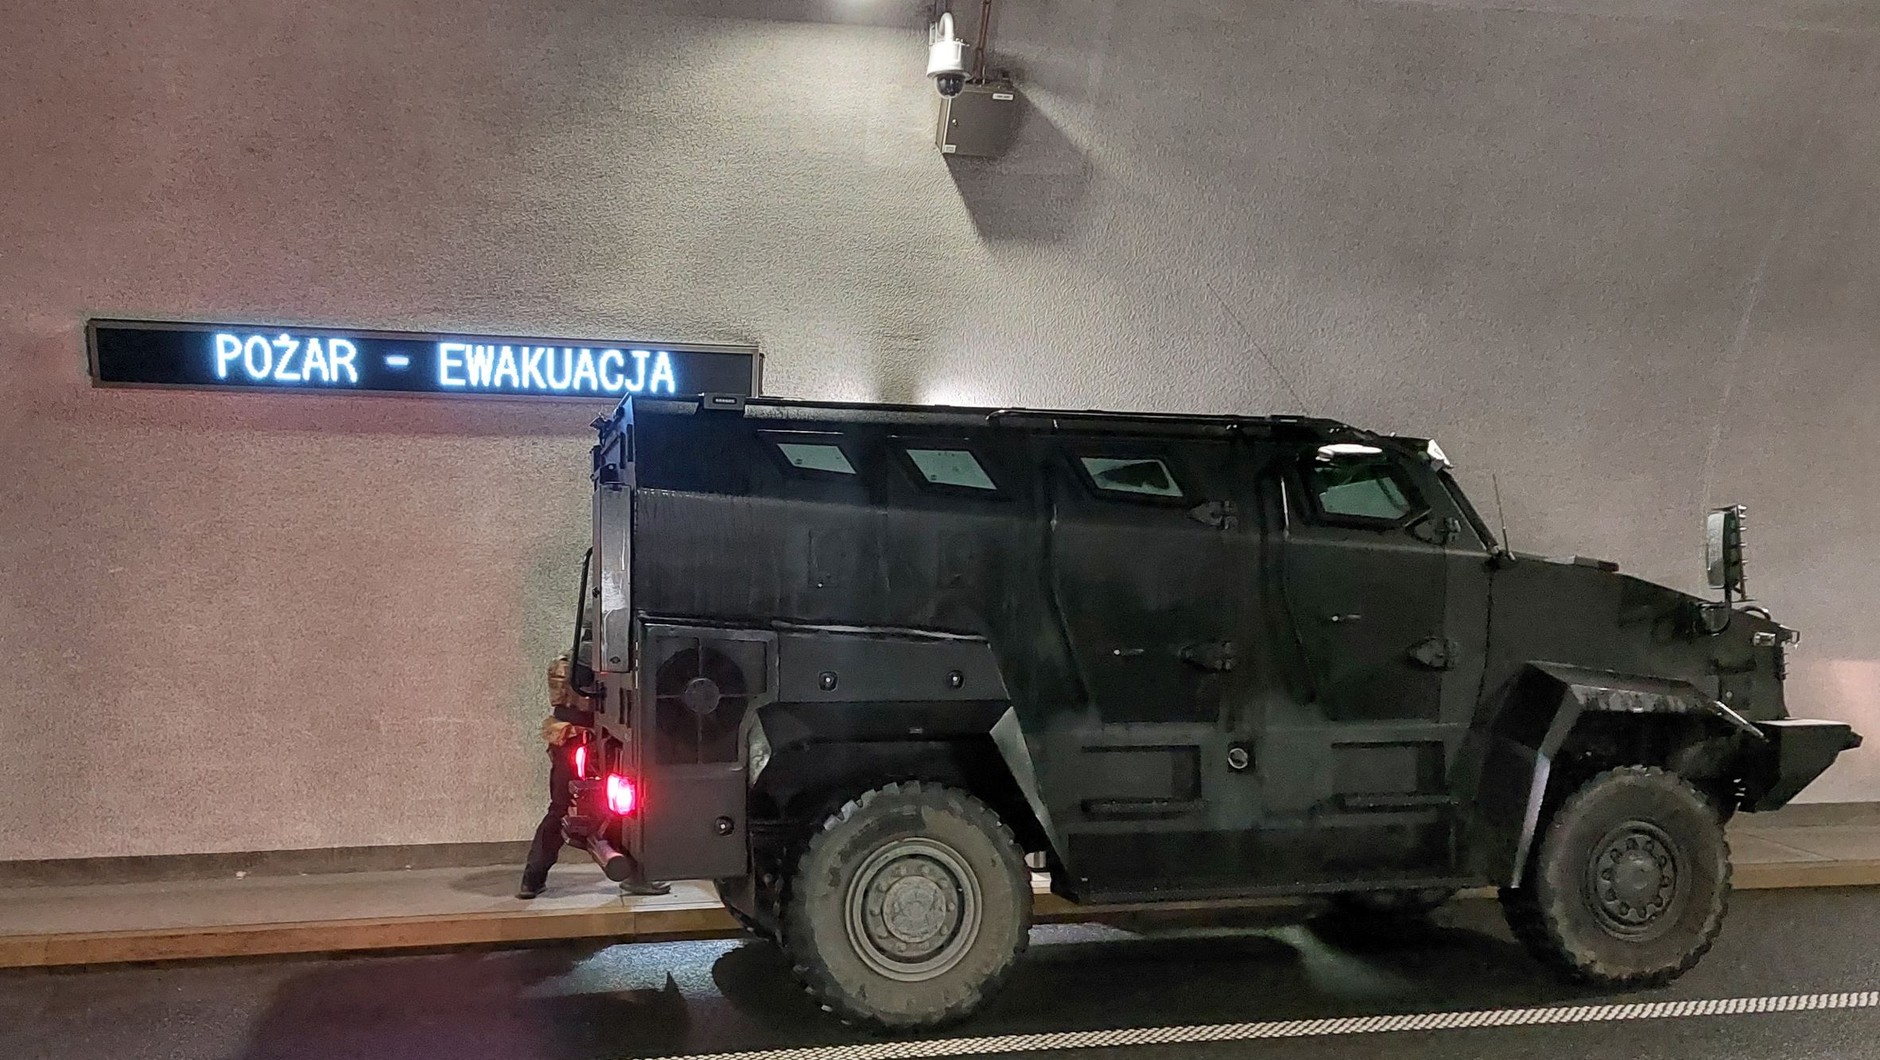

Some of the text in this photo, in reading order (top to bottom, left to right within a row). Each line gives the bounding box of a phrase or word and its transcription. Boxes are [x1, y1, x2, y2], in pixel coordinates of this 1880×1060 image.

[215, 333, 676, 394] POŻAR - EWAKUACJA
